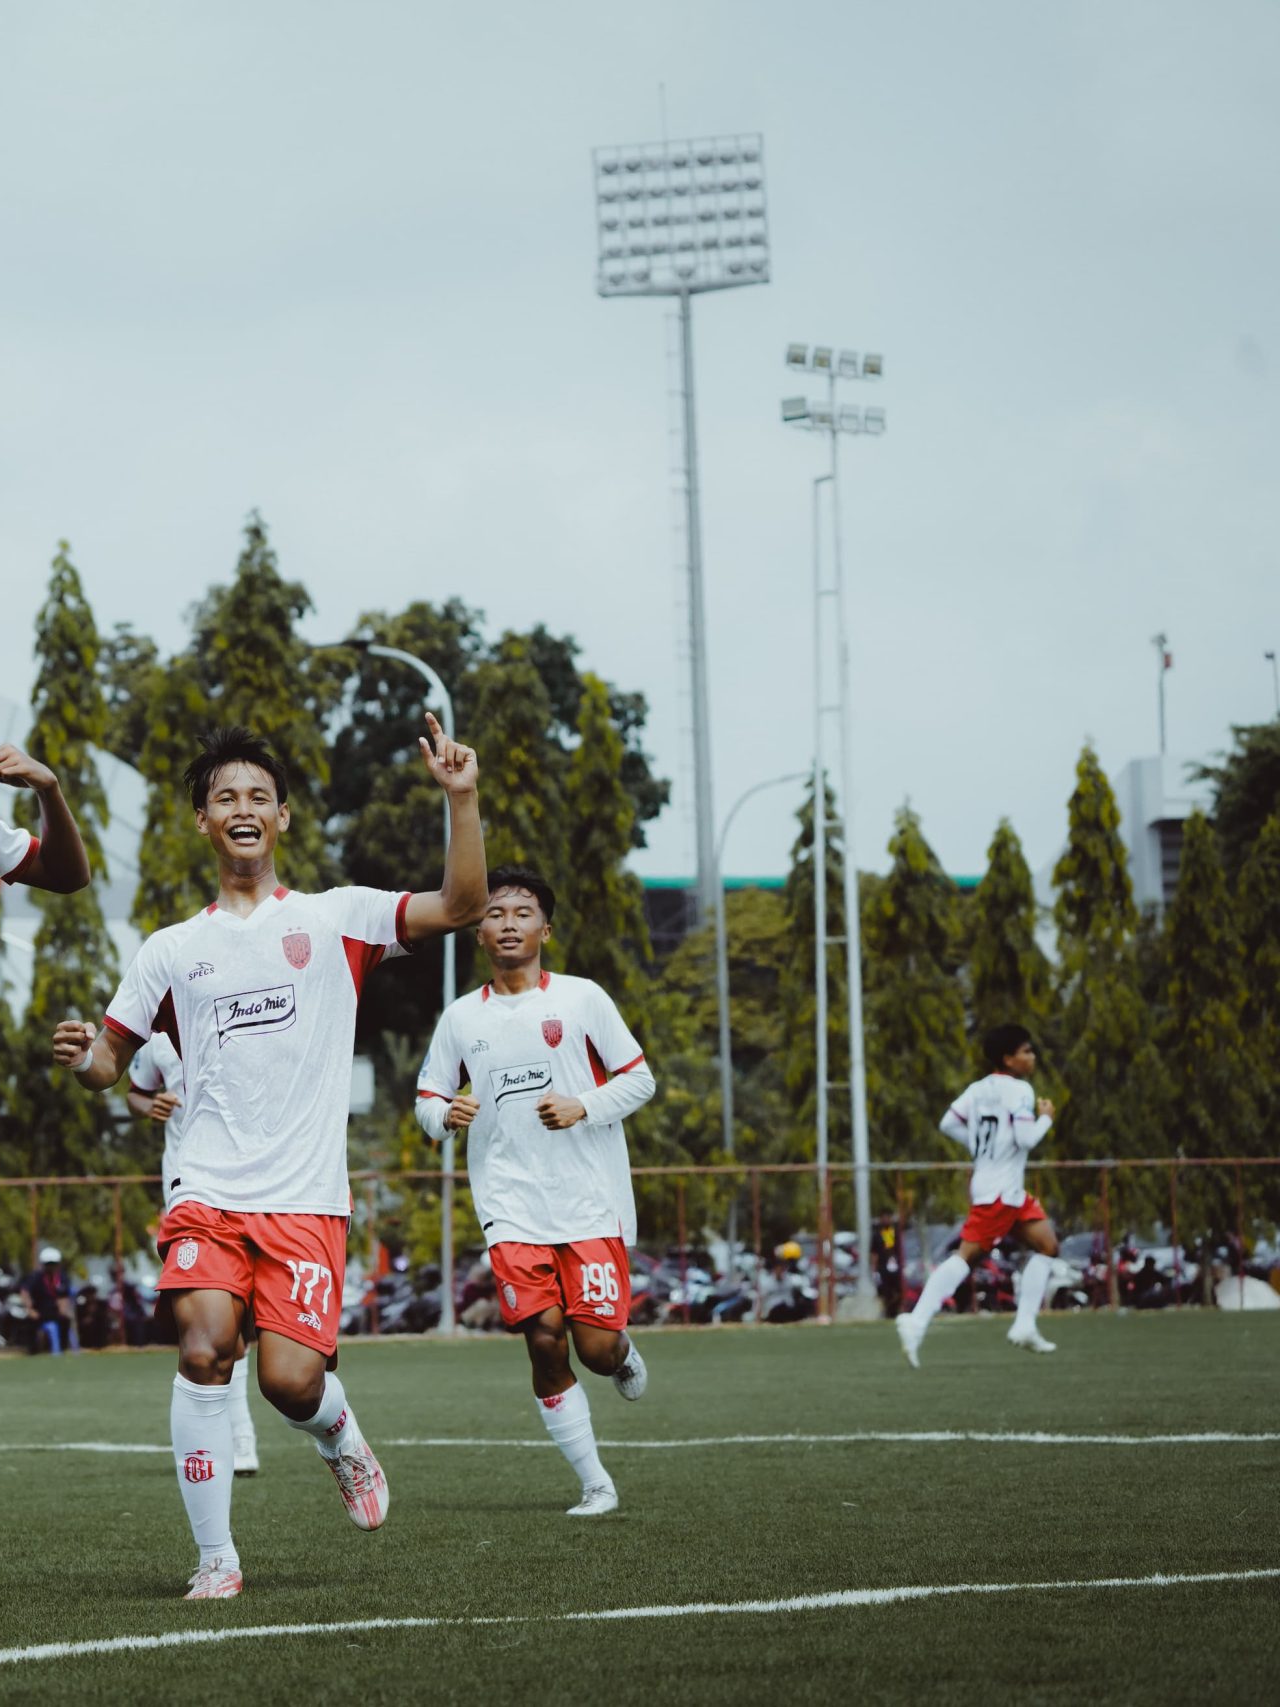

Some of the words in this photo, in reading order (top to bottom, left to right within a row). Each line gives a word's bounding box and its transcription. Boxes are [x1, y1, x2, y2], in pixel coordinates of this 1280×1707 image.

[188, 967, 216, 981] SPECS
[286, 1259, 333, 1315] 177
[580, 1262, 619, 1302] 196
